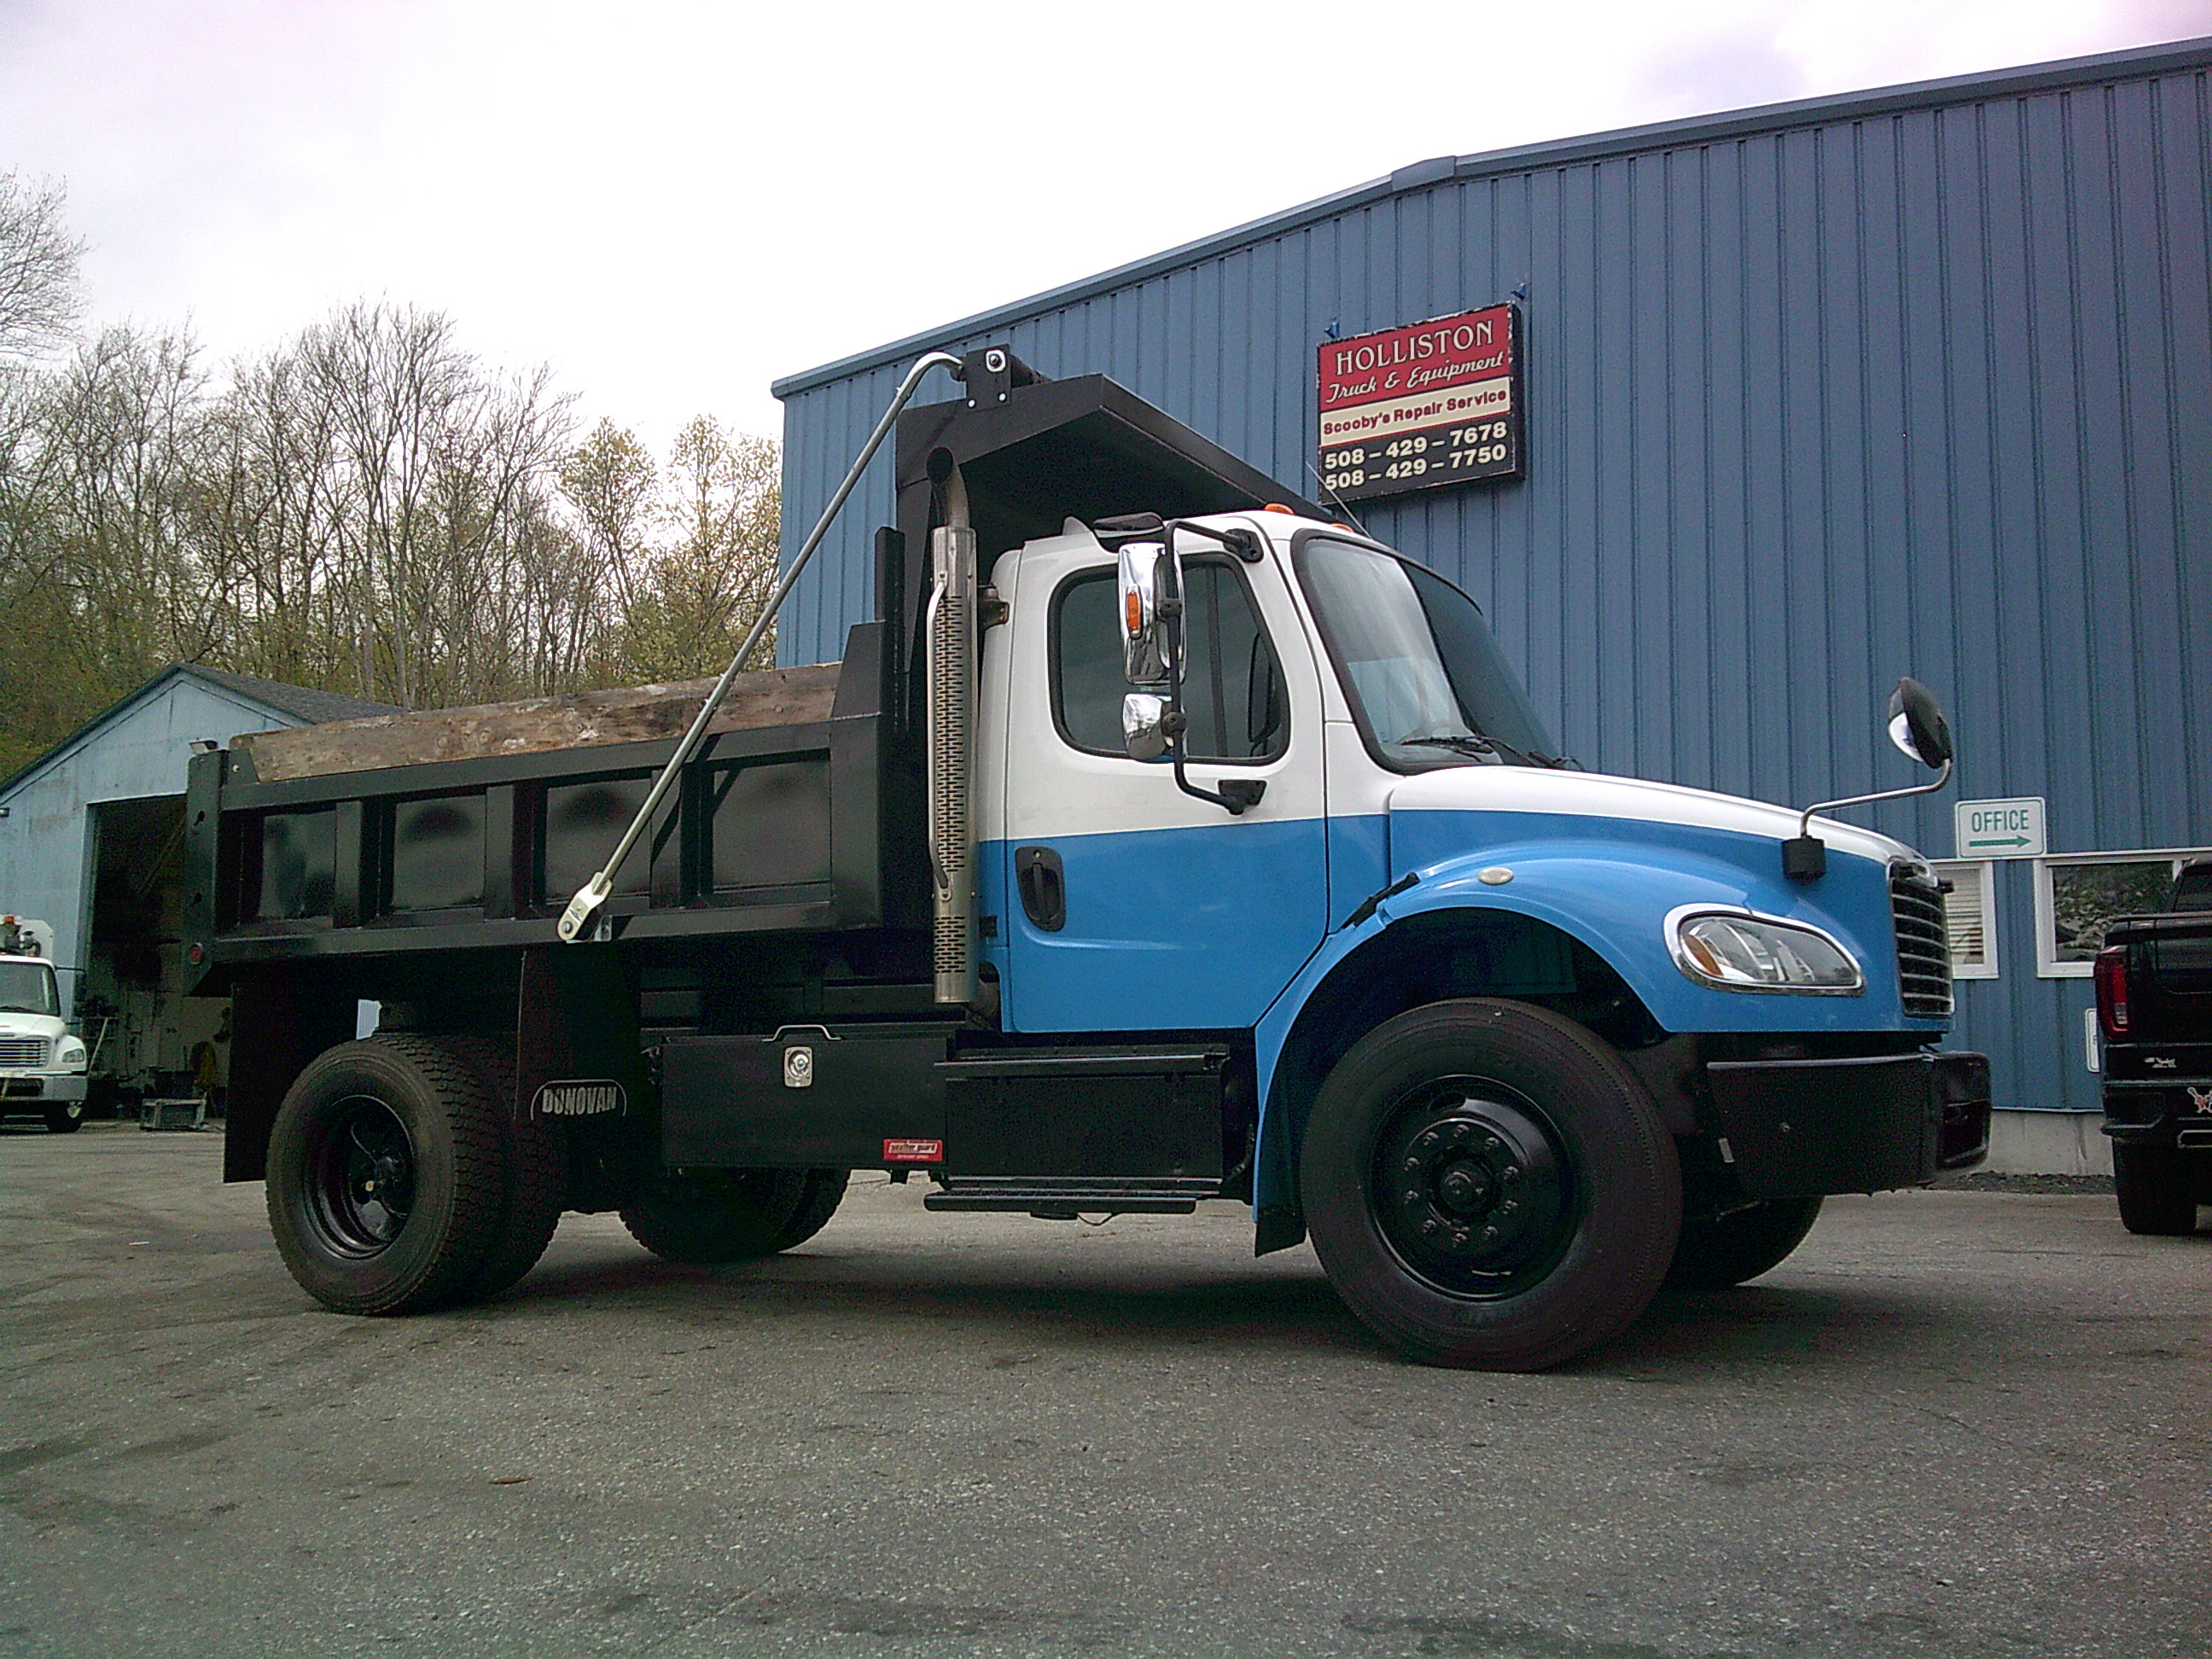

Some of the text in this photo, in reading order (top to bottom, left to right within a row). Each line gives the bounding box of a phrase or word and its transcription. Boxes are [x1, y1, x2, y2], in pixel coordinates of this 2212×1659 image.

[1336, 319, 1493, 375] HOLLISTON
[1325, 351, 1505, 404] Truck & Equipment
[1324, 389, 1507, 435] Scooby's Repair Service
[1971, 809, 2029, 833] OFFICE
[542, 1086, 617, 1115] DONOVAN
